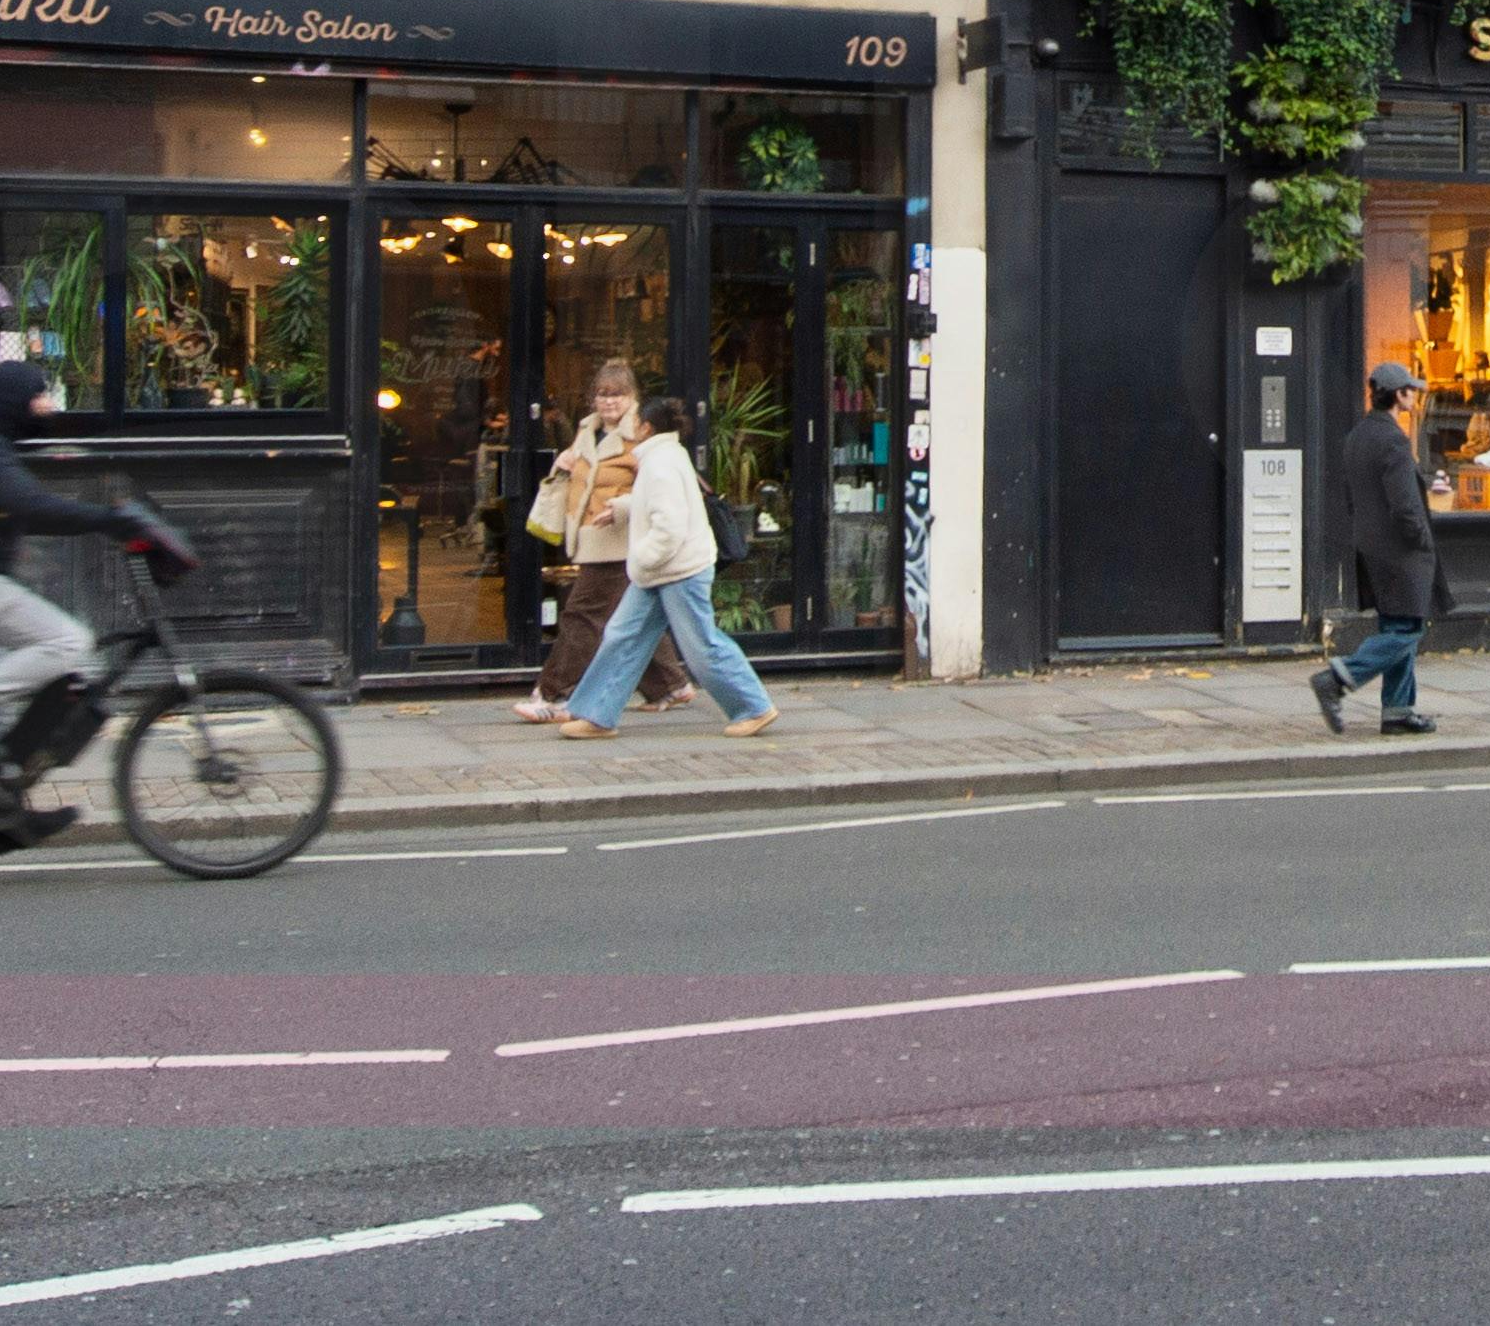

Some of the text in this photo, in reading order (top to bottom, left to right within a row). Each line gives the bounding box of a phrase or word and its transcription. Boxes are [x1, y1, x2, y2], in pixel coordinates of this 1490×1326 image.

[205, 7, 293, 39] Hair
[294, 10, 398, 43] Salon
[845, 35, 908, 67] 109
[1261, 459, 1286, 476] 108
